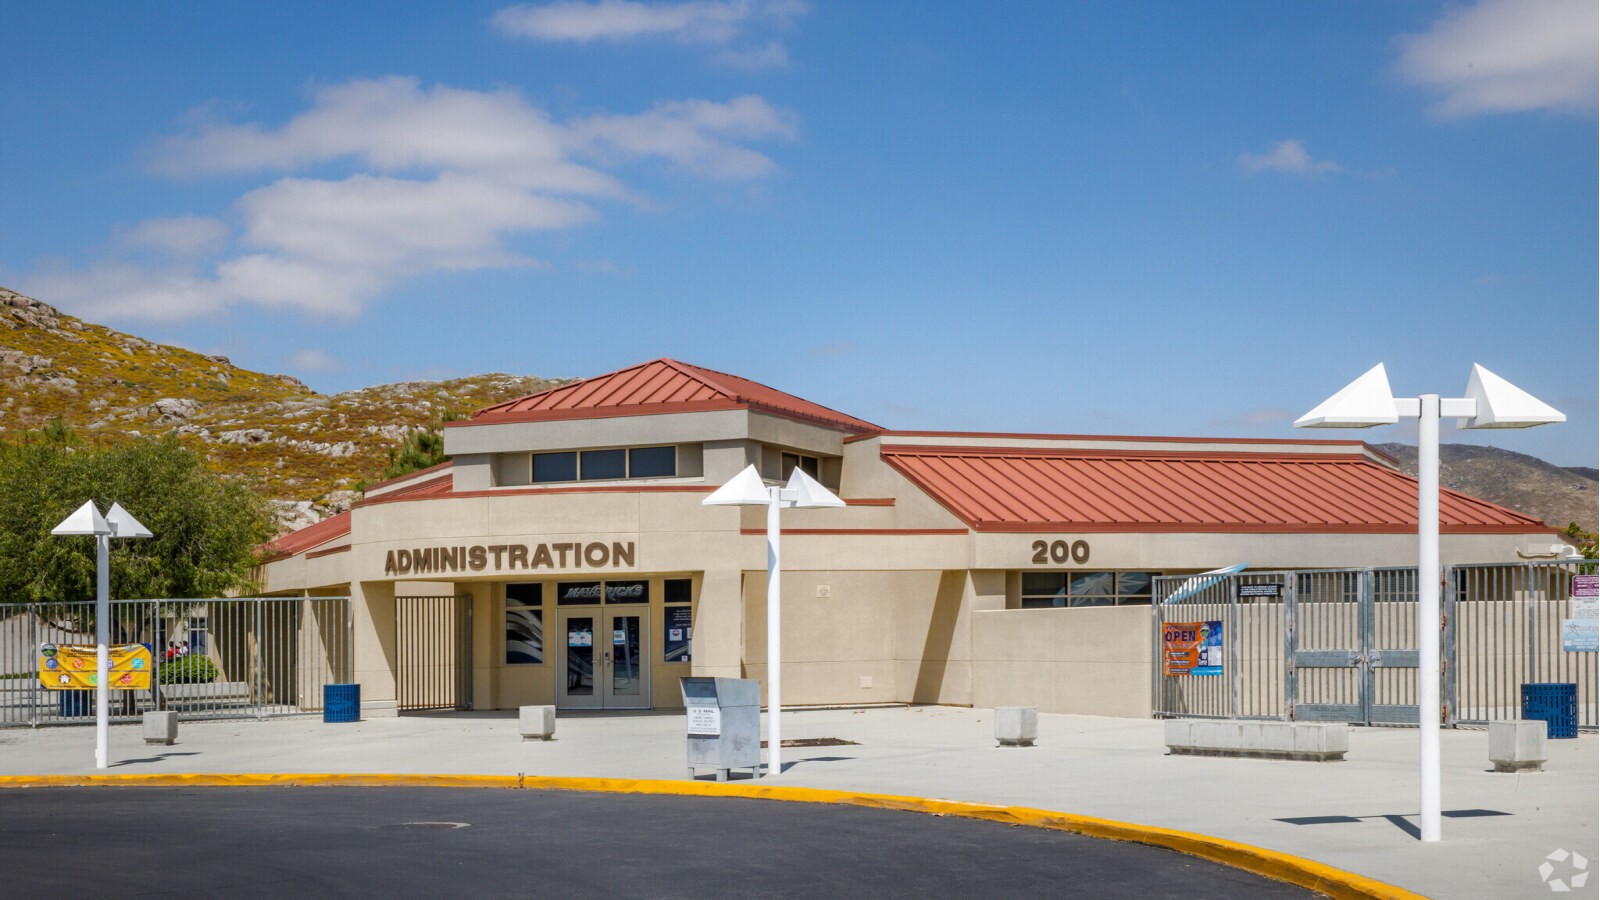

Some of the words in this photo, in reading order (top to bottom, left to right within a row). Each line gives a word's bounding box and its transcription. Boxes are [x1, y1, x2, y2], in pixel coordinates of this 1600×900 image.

[385, 542, 634, 575] ADMINISTRATION
[1032, 539, 1090, 564] 200
[565, 585, 643, 600] MAVERICKS
[1165, 631, 1196, 642] OPEN
